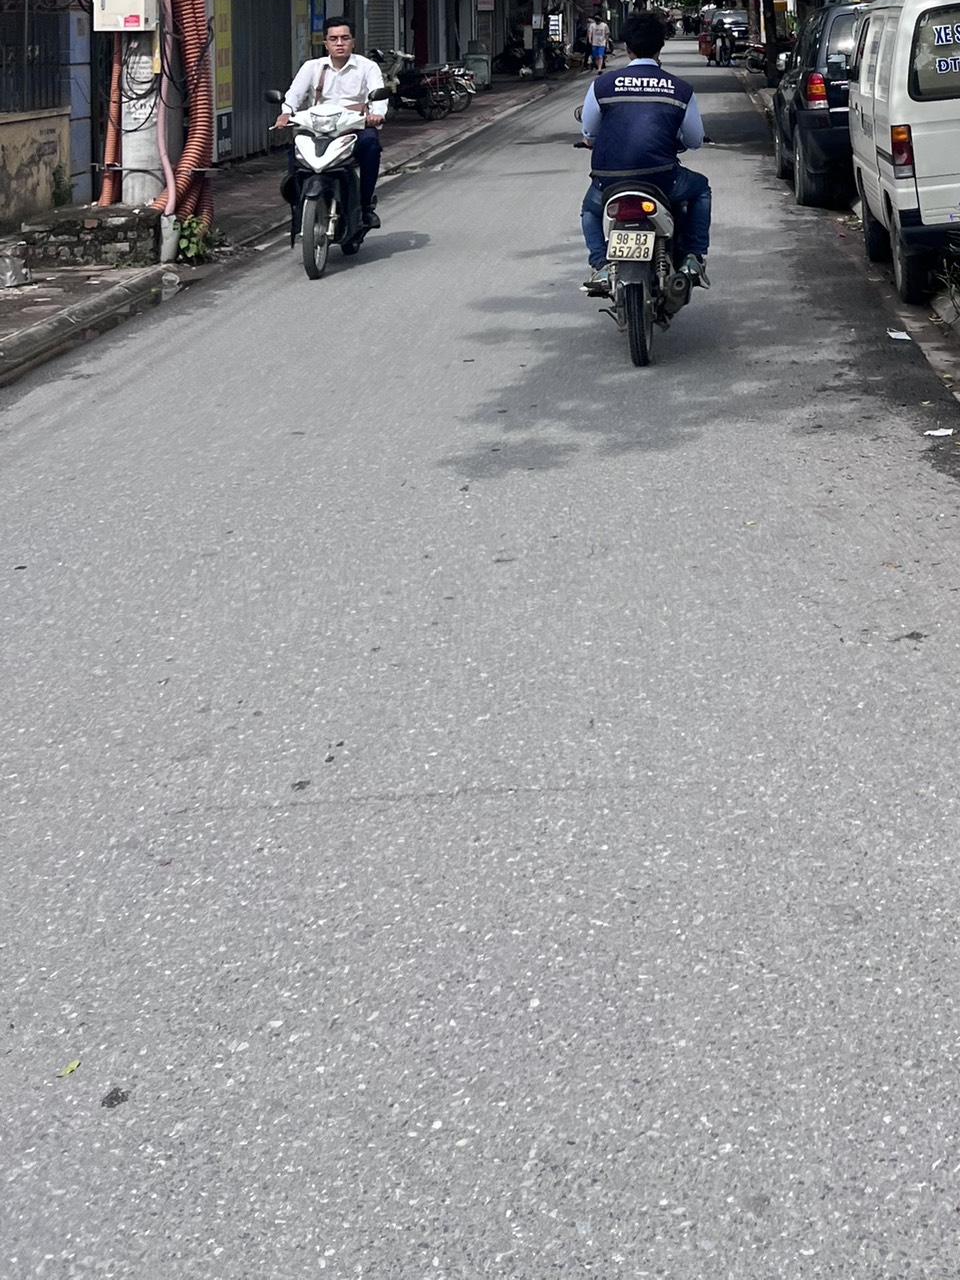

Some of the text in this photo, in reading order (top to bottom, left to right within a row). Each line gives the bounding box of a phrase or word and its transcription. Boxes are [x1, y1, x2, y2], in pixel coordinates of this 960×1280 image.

[934, 25, 952, 45] XE
[614, 77, 675, 89] CENTRAL
[616, 233, 648, 245] 98-B3
